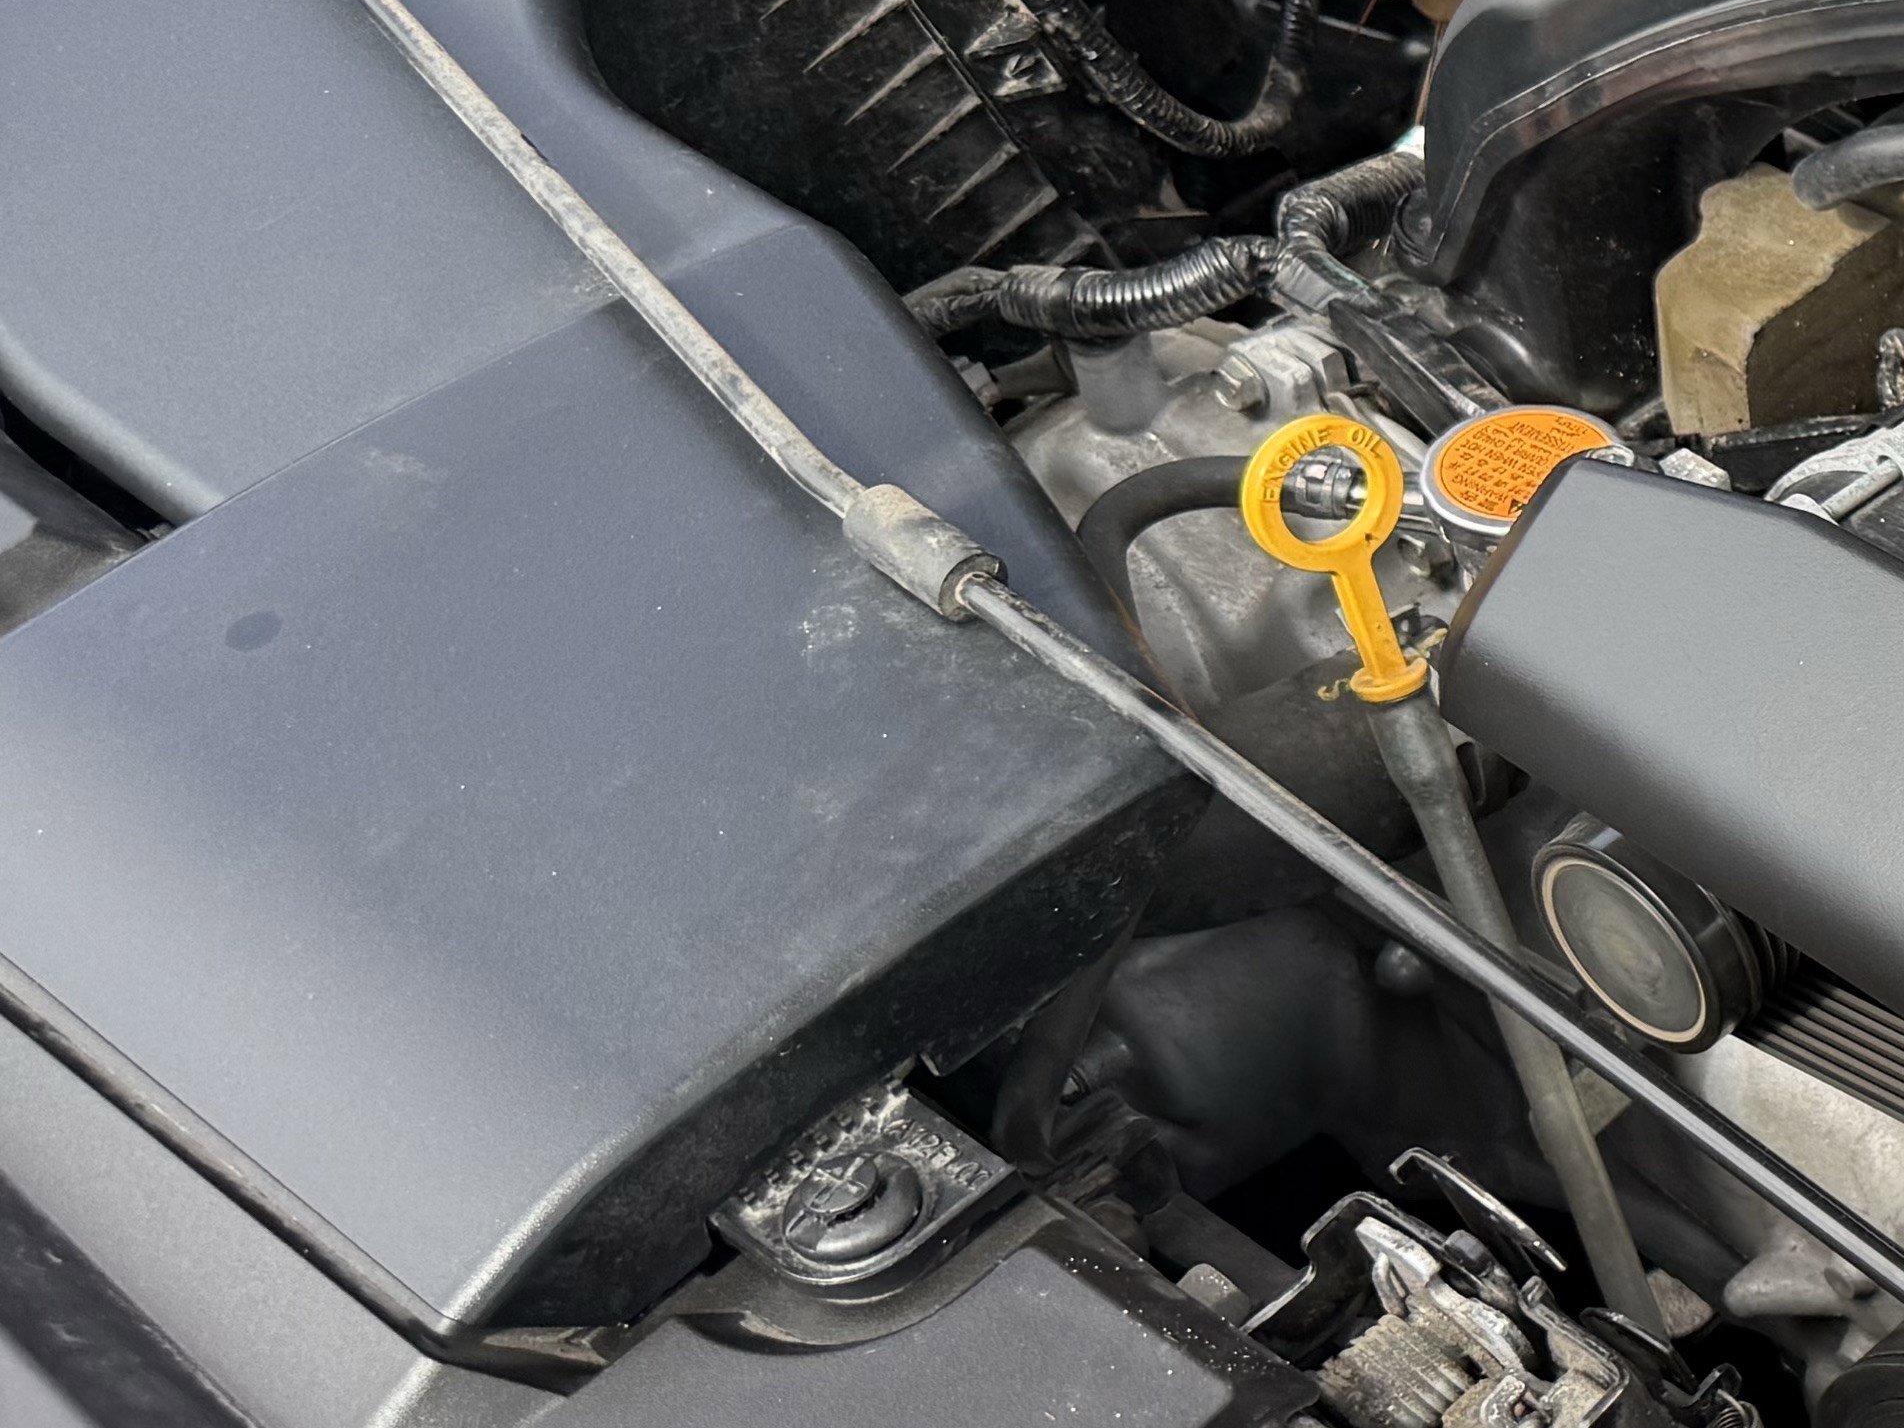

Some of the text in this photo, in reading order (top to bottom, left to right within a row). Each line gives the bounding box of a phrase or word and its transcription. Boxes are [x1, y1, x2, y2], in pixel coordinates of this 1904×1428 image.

[1349, 426, 1385, 459] OIL
[1510, 422, 1573, 452] TISSEMENT
[1263, 425, 1332, 503] ENGINE
